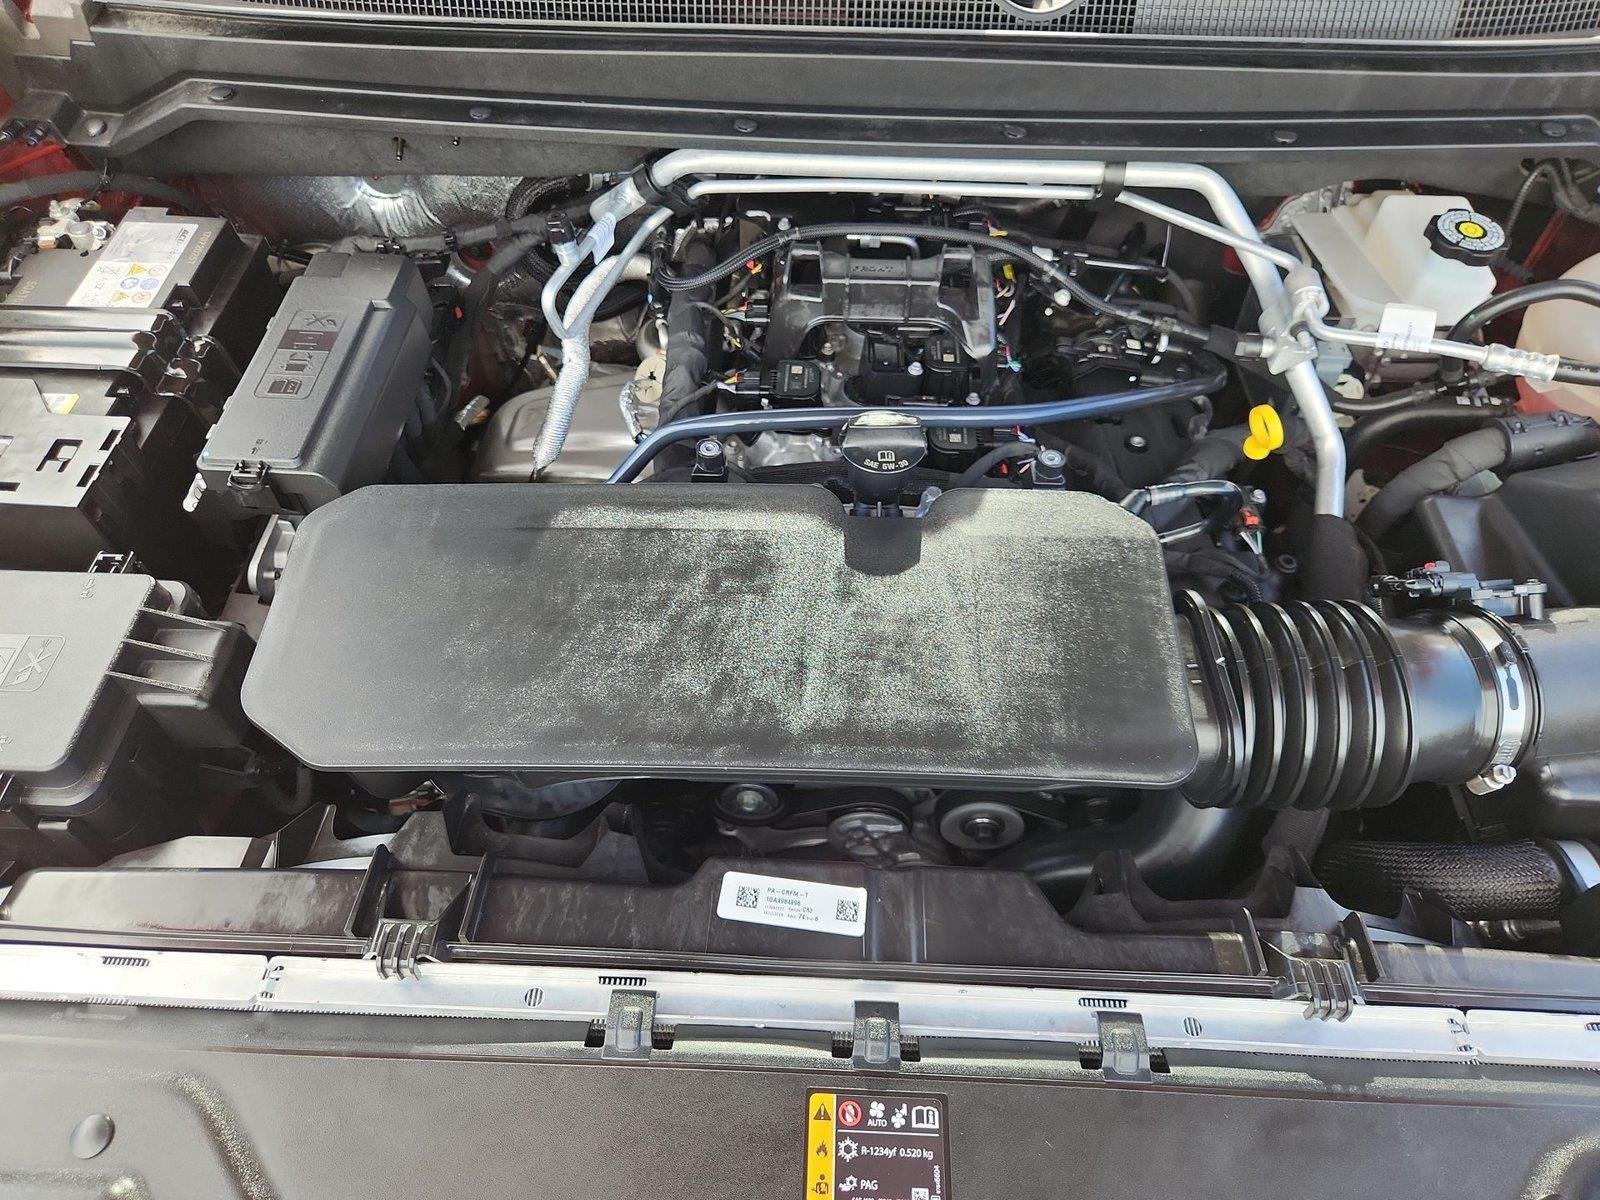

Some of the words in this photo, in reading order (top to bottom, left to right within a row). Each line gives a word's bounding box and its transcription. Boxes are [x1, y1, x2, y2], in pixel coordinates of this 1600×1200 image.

[863, 459, 880, 469] SAE
[867, 1118, 888, 1127] AUTO
[861, 1145, 898, 1159] R-1234yf
[899, 1148, 922, 1158] 0.520
[922, 1148, 934, 1161] kg
[860, 1179, 879, 1191] PAG
